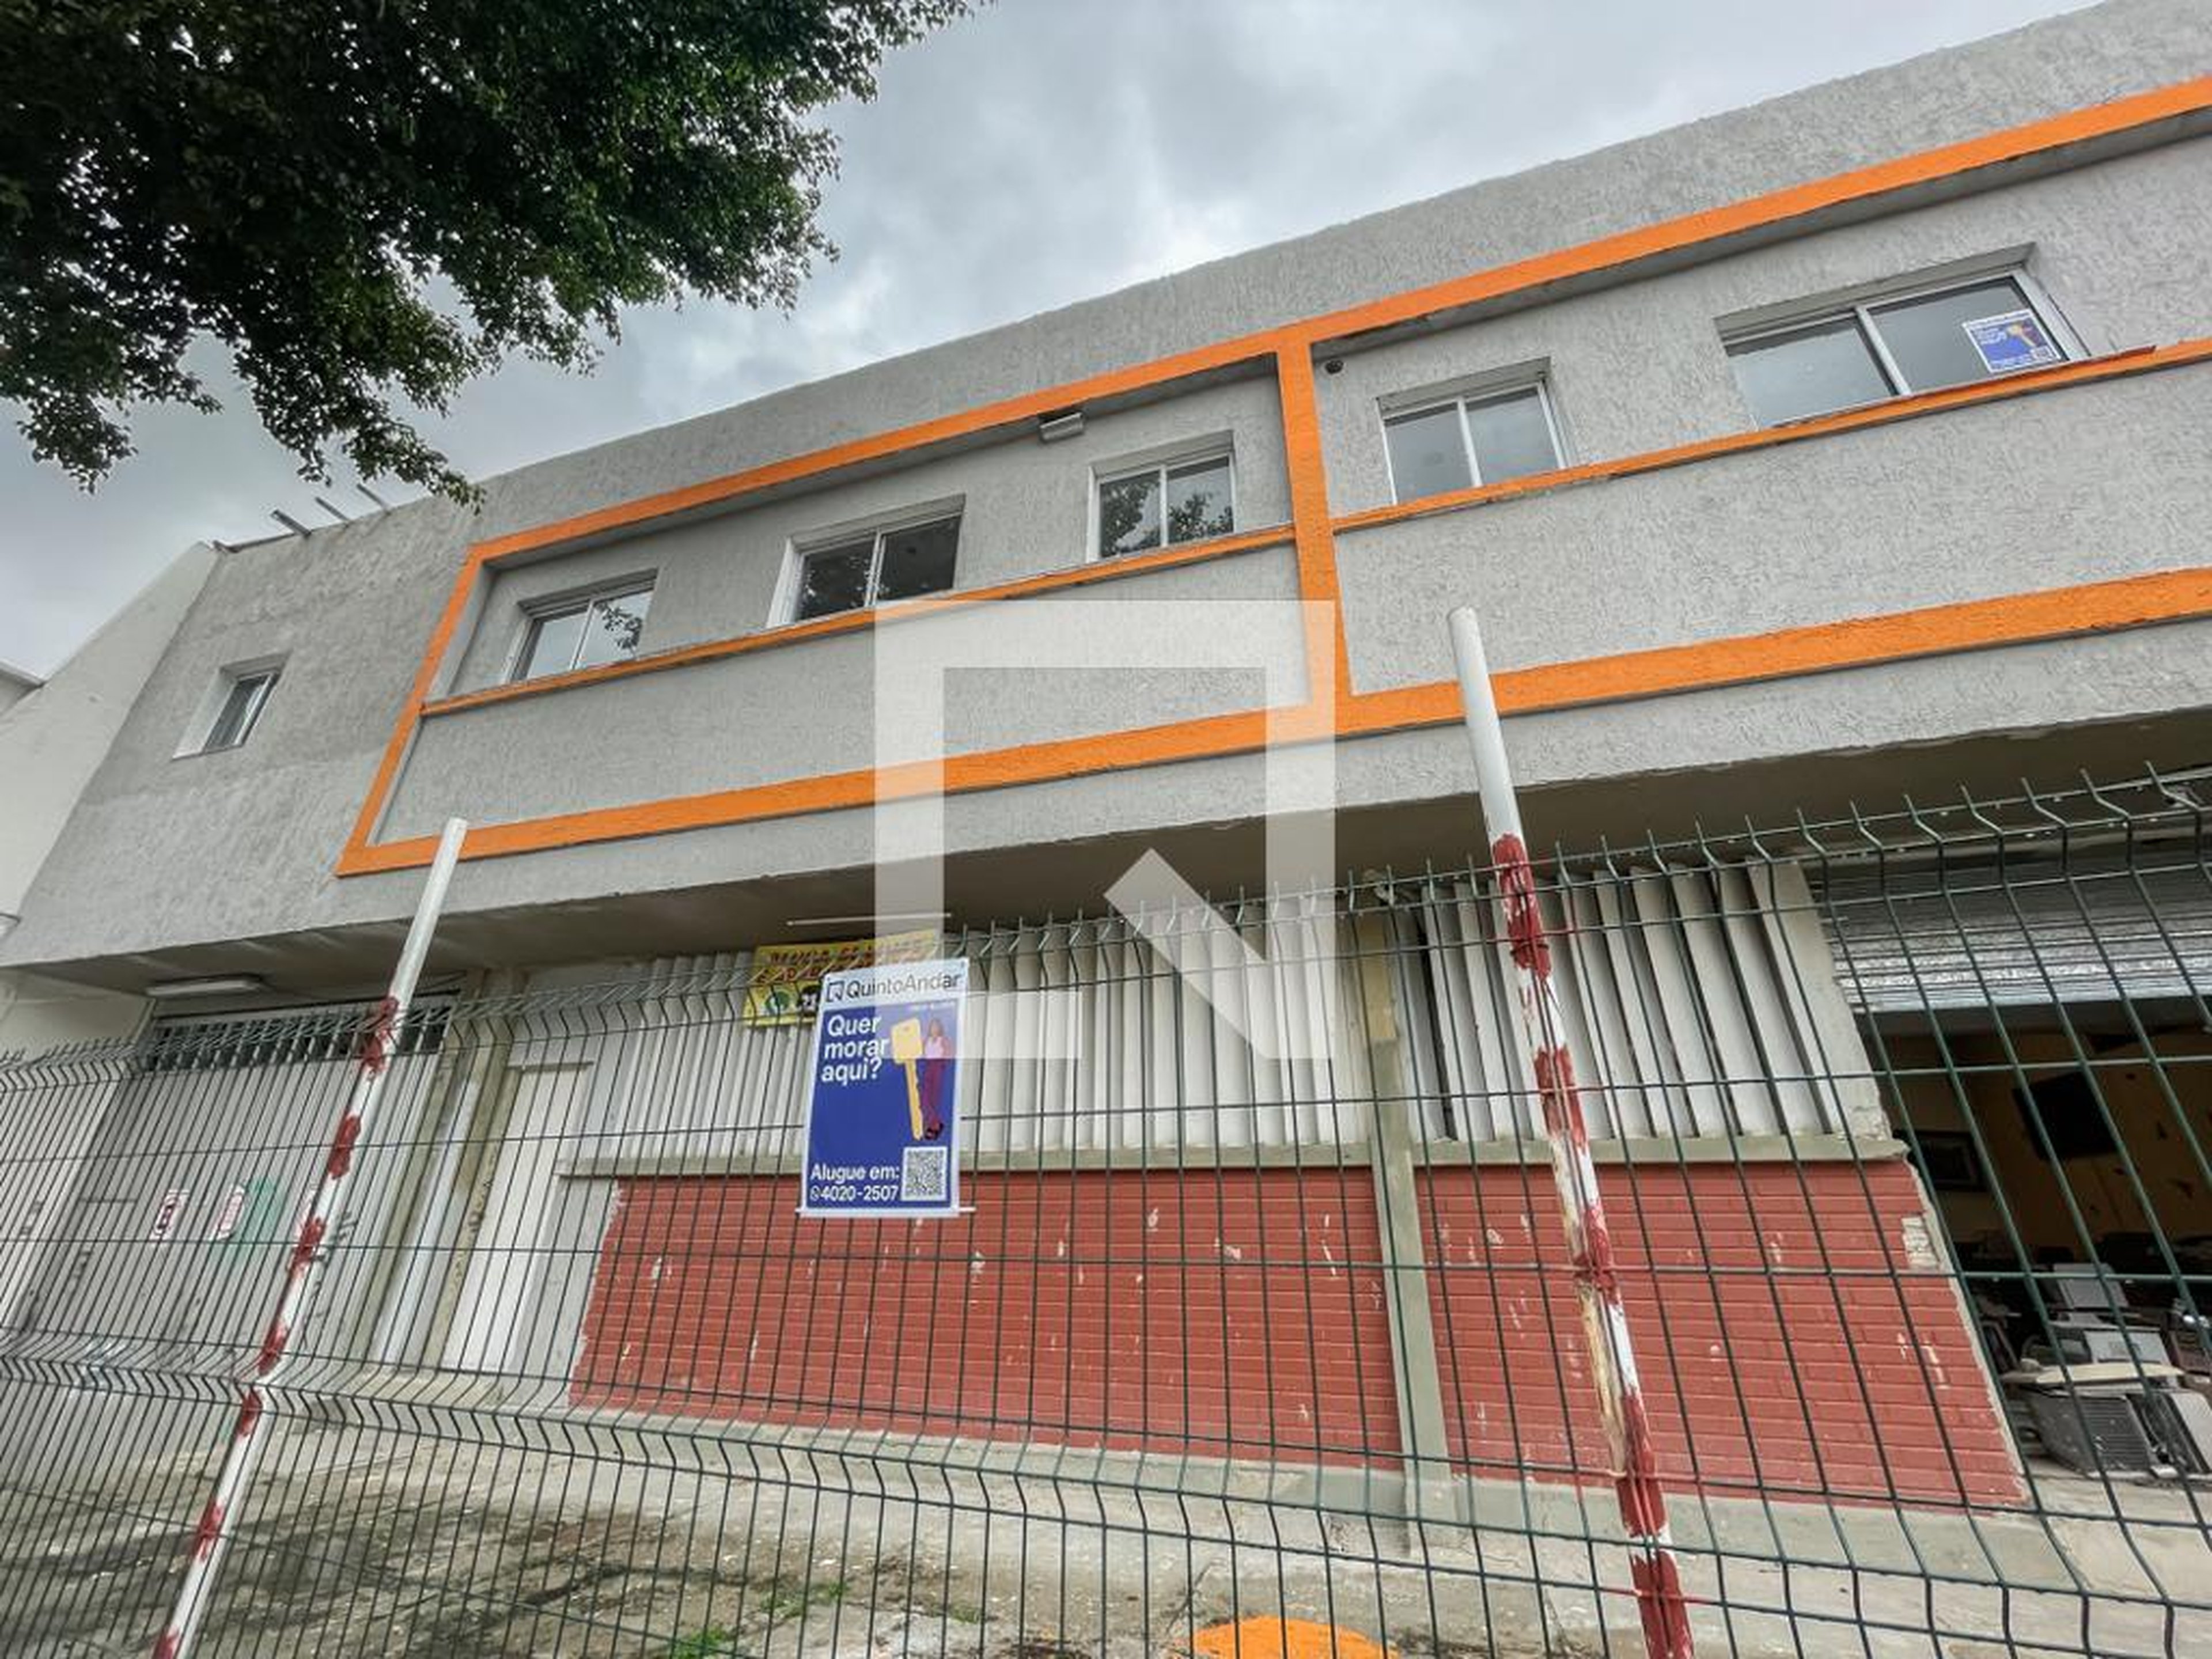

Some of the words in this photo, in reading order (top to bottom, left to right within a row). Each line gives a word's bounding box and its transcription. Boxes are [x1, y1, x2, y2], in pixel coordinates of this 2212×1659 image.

[846, 973, 961, 998] QuintoAndar
[828, 1015, 881, 1036] Quer
[825, 1039, 889, 1058] morar
[822, 1057, 881, 1085] aqui?
[810, 1164, 865, 1184] Alugue
[869, 1166, 900, 1180] em:
[821, 1185, 898, 1202] 4020-2507
